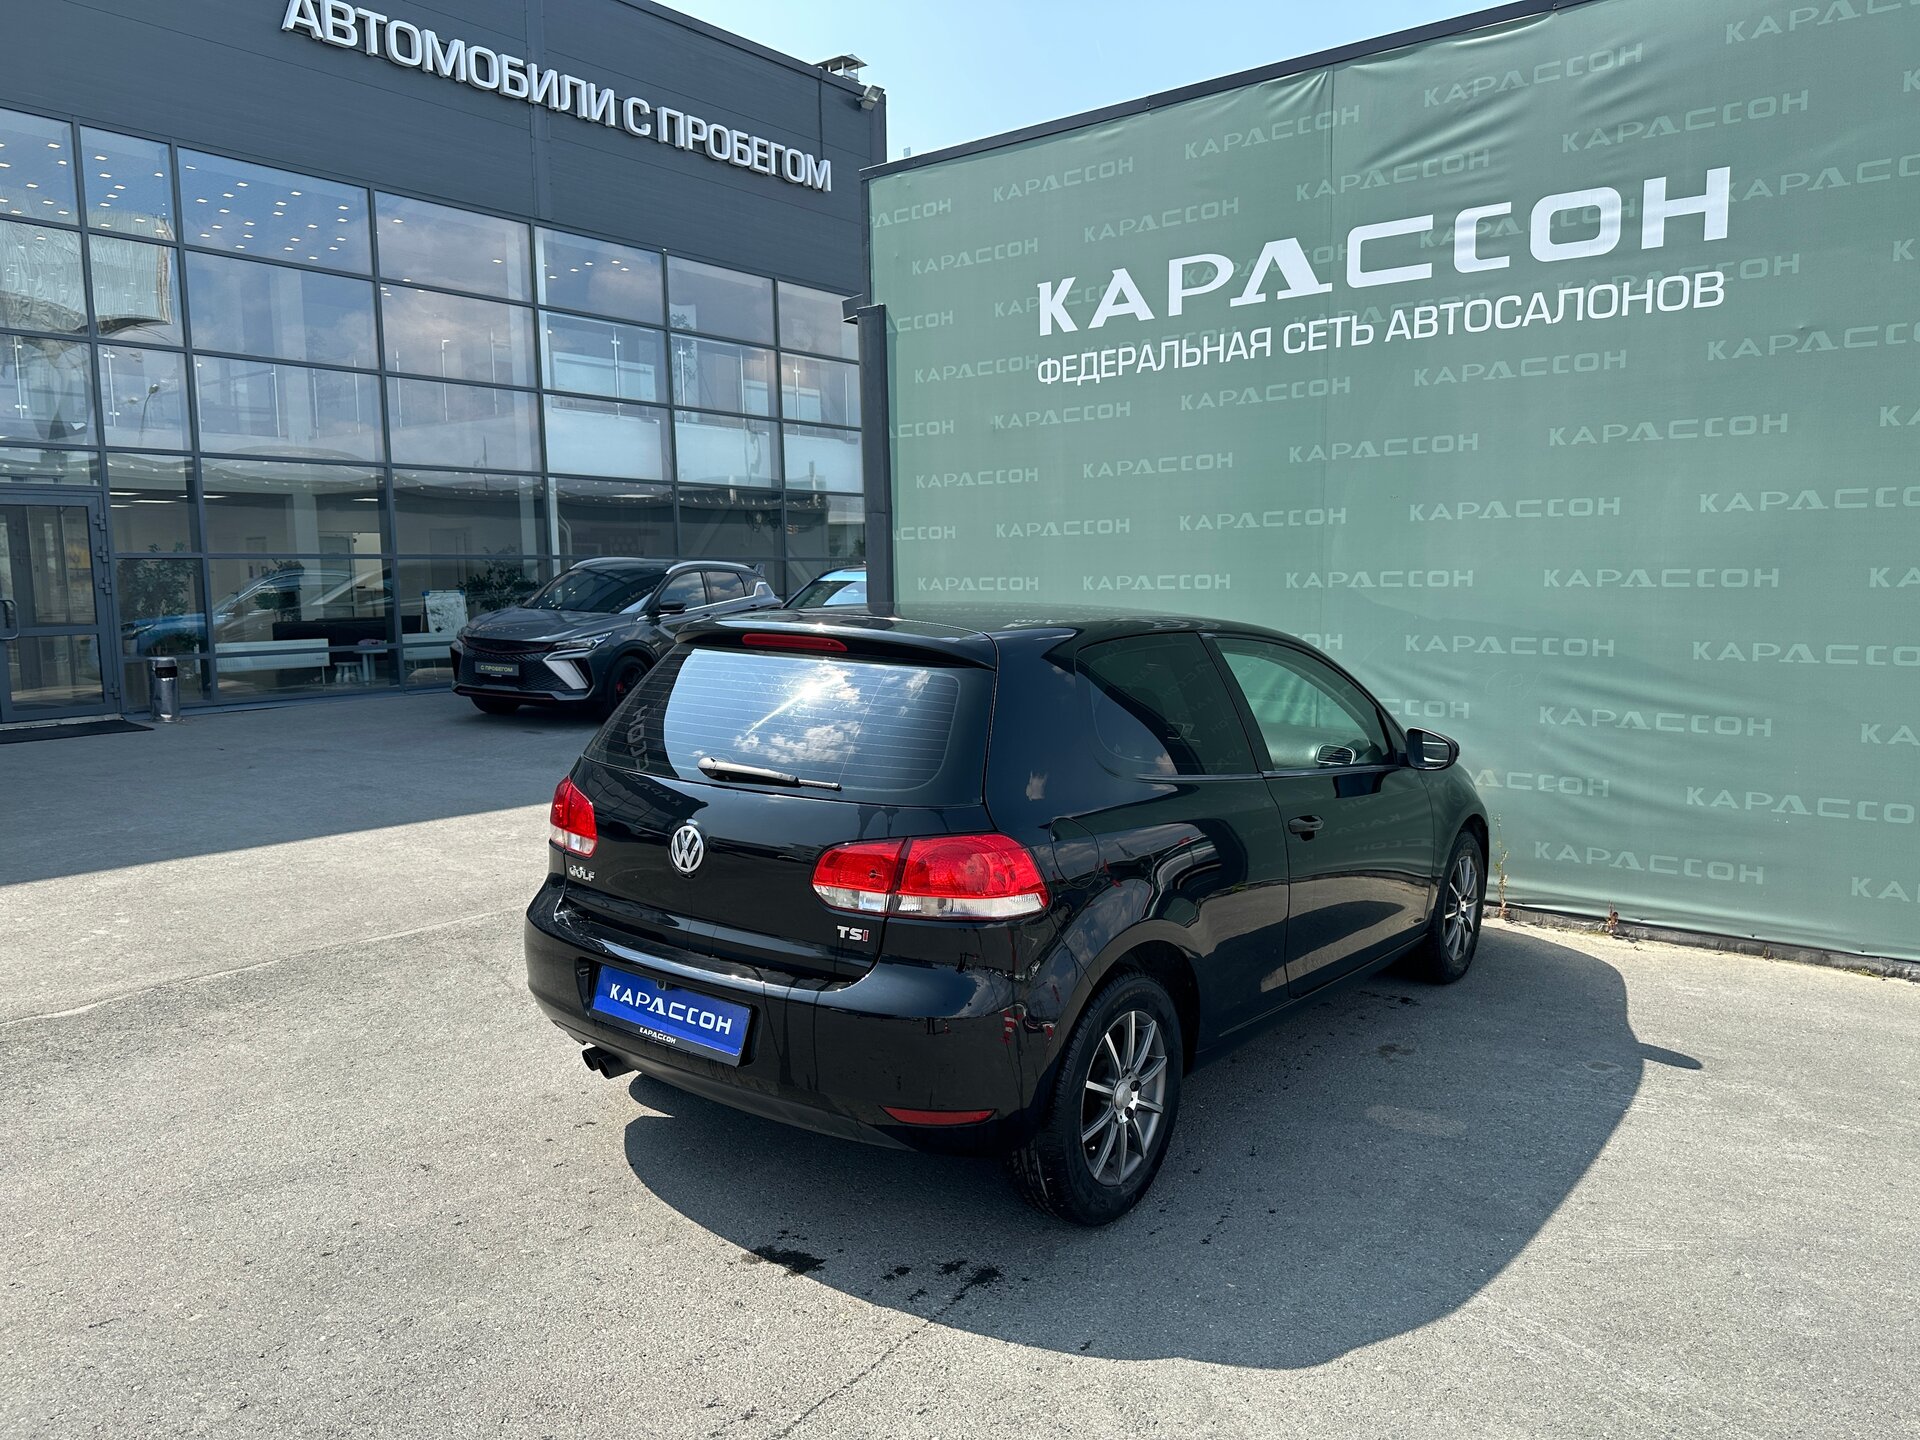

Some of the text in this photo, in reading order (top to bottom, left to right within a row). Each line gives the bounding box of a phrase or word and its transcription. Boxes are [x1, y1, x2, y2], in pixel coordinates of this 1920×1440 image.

[281, 0, 832, 192] АВТОМОБИЛИ С ПРОБЕГОМ
[1037, 166, 1730, 337] КАРАССОН
[1037, 271, 1726, 386] ФЕДЕРАЛЬНАЯ СЕТЬ АВТОСАЛОНОВ
[569, 864, 595, 881] GOLF
[609, 983, 733, 1035] КАРАССОН
